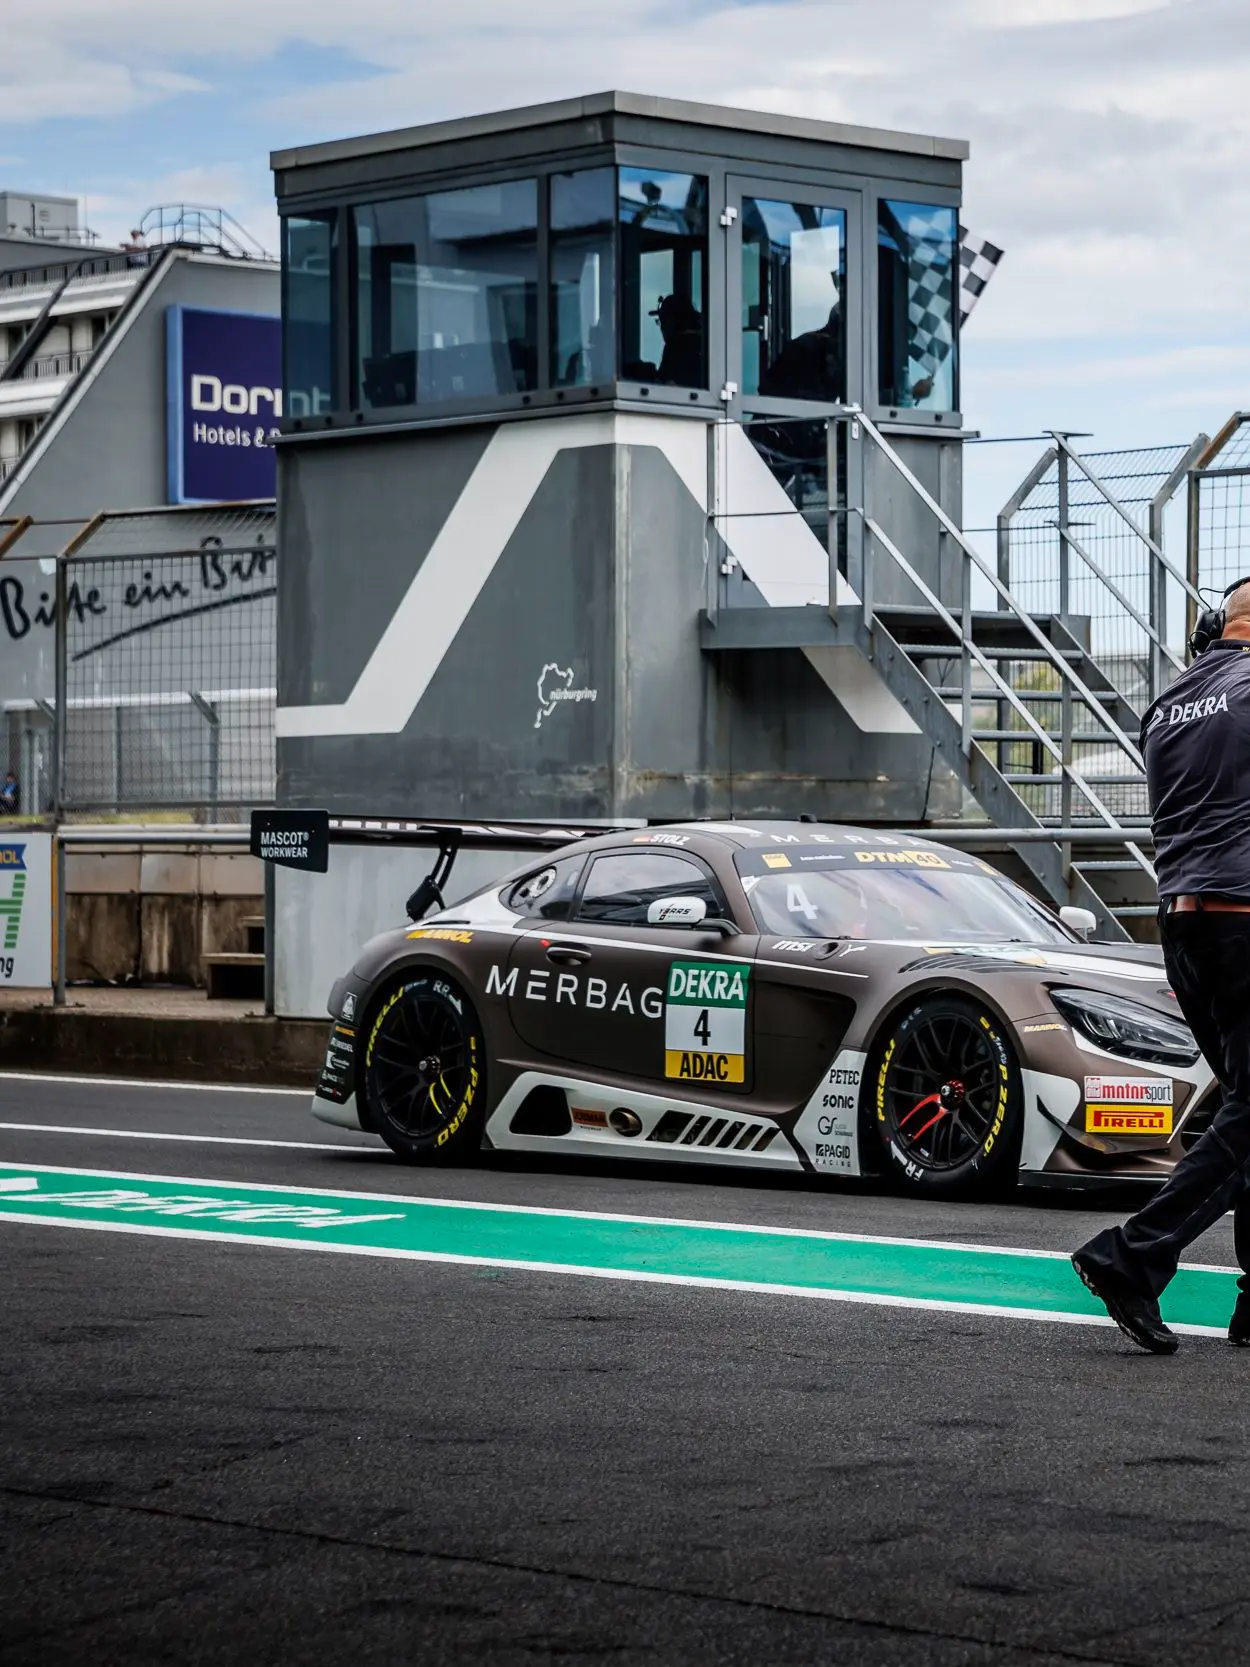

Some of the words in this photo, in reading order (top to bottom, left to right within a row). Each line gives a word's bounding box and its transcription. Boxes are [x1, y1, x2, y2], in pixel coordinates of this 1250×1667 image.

[193, 422, 250, 447] Hotels
[124, 572, 190, 609] ein
[1169, 693, 1229, 725] DEKRA
[260, 847, 308, 858] WORKWEAR
[650, 834, 690, 846] STOLZ
[854, 851, 914, 863] DTM
[787, 884, 819, 920] 4
[485, 965, 664, 1019] MERBAG
[669, 968, 745, 1001] DEKRA
[693, 1009, 711, 1046] 4
[679, 1052, 728, 1081] ADAC
[829, 1069, 860, 1086] PETEC
[877, 1038, 896, 1121] PIRELLI
[984, 1085, 1008, 1155] ZERO
[1093, 1110, 1164, 1128] PIRELLI
[824, 1144, 851, 1159] PAGID
